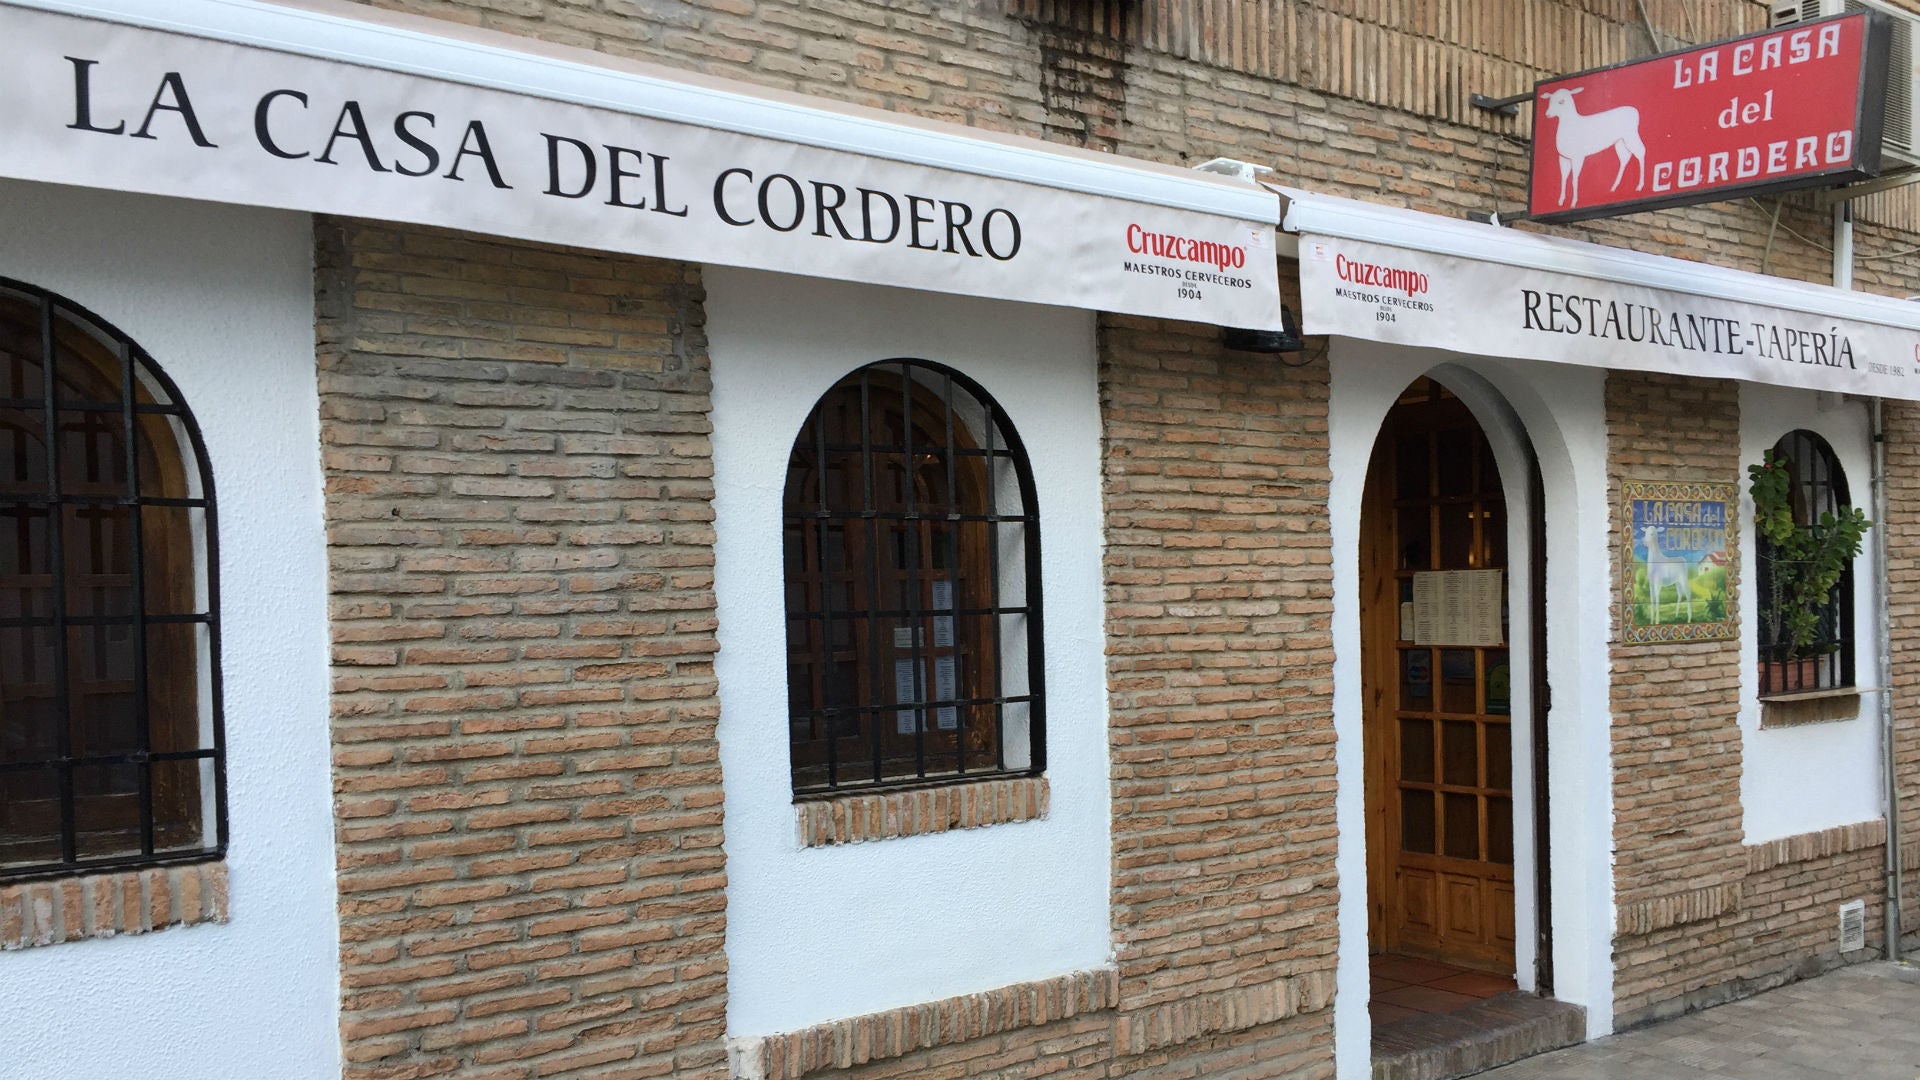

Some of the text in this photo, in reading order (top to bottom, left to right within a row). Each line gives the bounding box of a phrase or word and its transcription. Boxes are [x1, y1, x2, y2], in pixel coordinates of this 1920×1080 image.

[1673, 24, 1841, 89] LA CASA
[1718, 89, 1774, 129] del
[64, 55, 1022, 261] LA CASA DEL CORDERO
[1652, 129, 1853, 192] CORDERO
[1127, 223, 1246, 272] Cruzcampo
[1124, 261, 1252, 288] MAESTROS CERVECEROS
[1177, 288, 1202, 300] 1904
[1336, 253, 1428, 297] Cruzcampo
[1335, 288, 1380, 303] MAESTROS
[1382, 295, 1434, 312] CERVECEROS
[1376, 311, 1396, 322] 1904
[1521, 289, 1857, 370] RESTAURANTE-TAPERÍA
